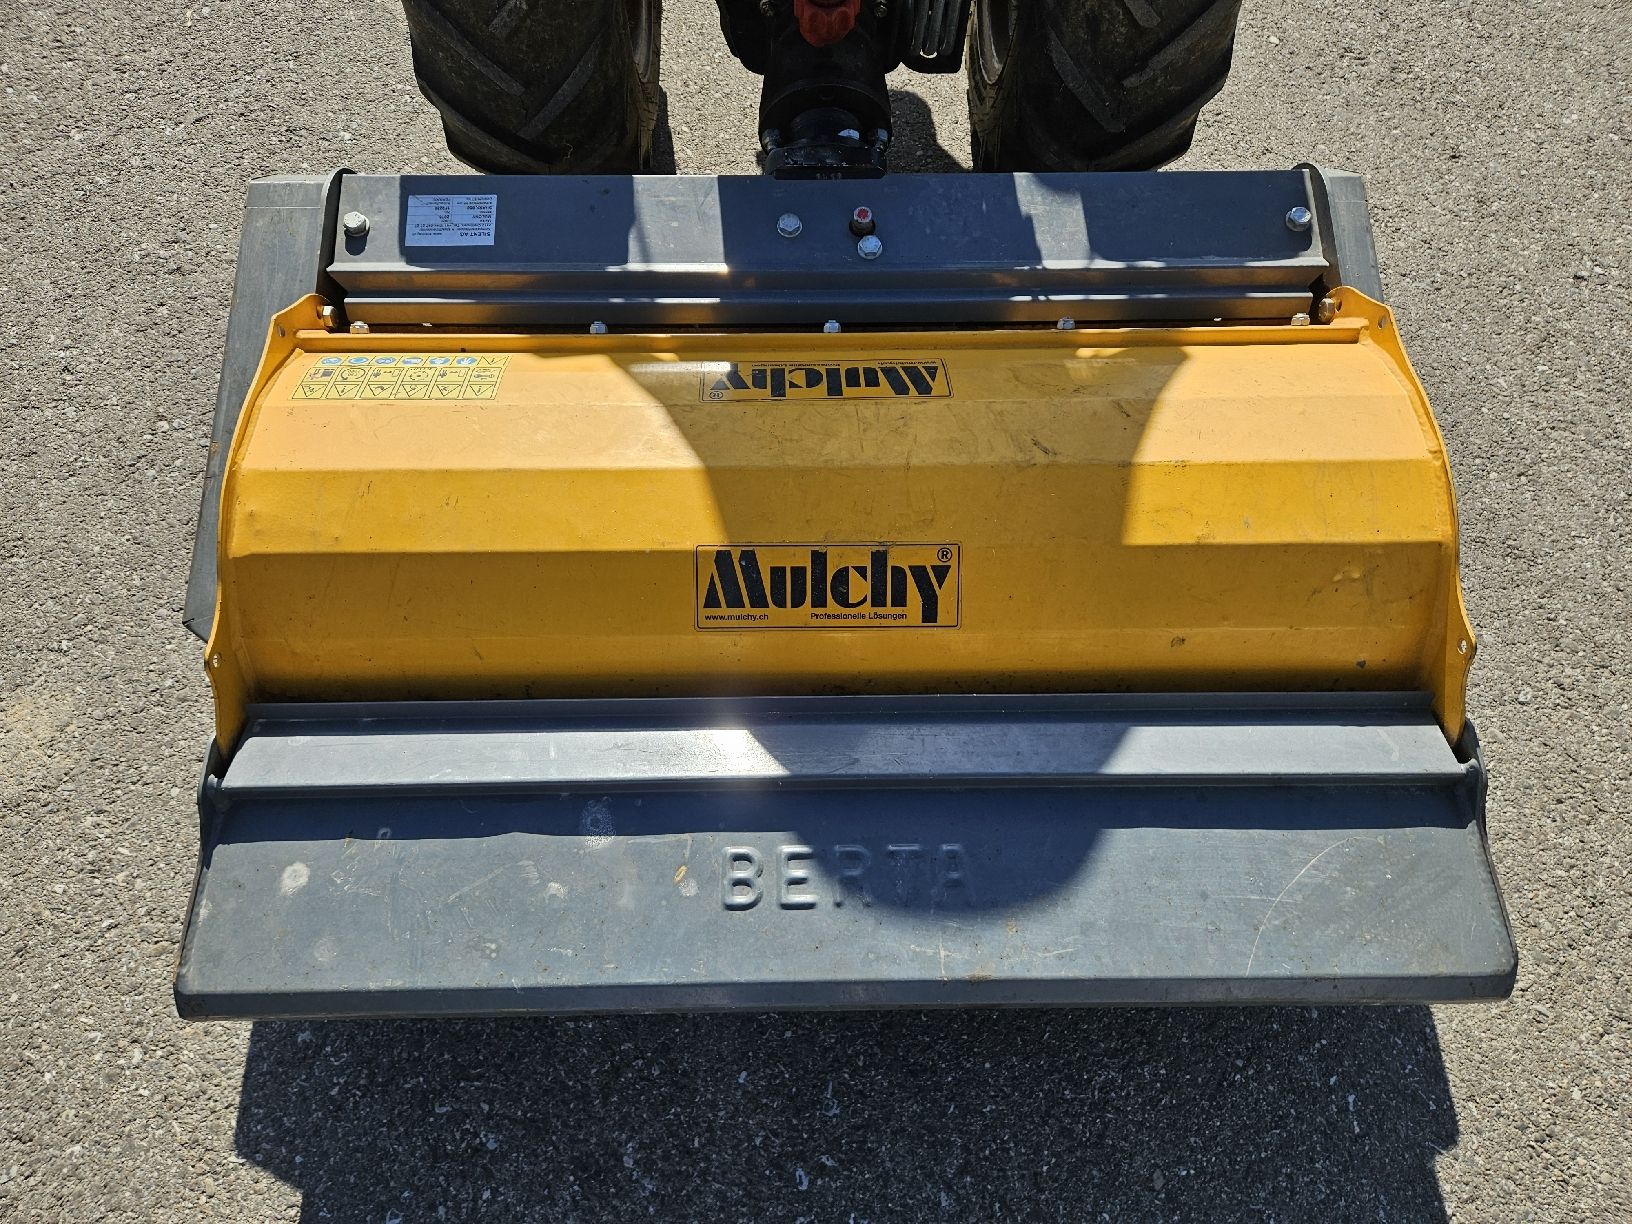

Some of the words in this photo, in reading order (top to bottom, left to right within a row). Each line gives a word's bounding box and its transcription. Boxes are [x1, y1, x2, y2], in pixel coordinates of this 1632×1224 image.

[703, 549, 952, 624] Mulchy
[704, 612, 769, 622] www.mulchy.ch
[810, 612, 866, 620] Professionelle
[868, 611, 908, 621] Lösungen
[722, 843, 975, 911] BERTA
